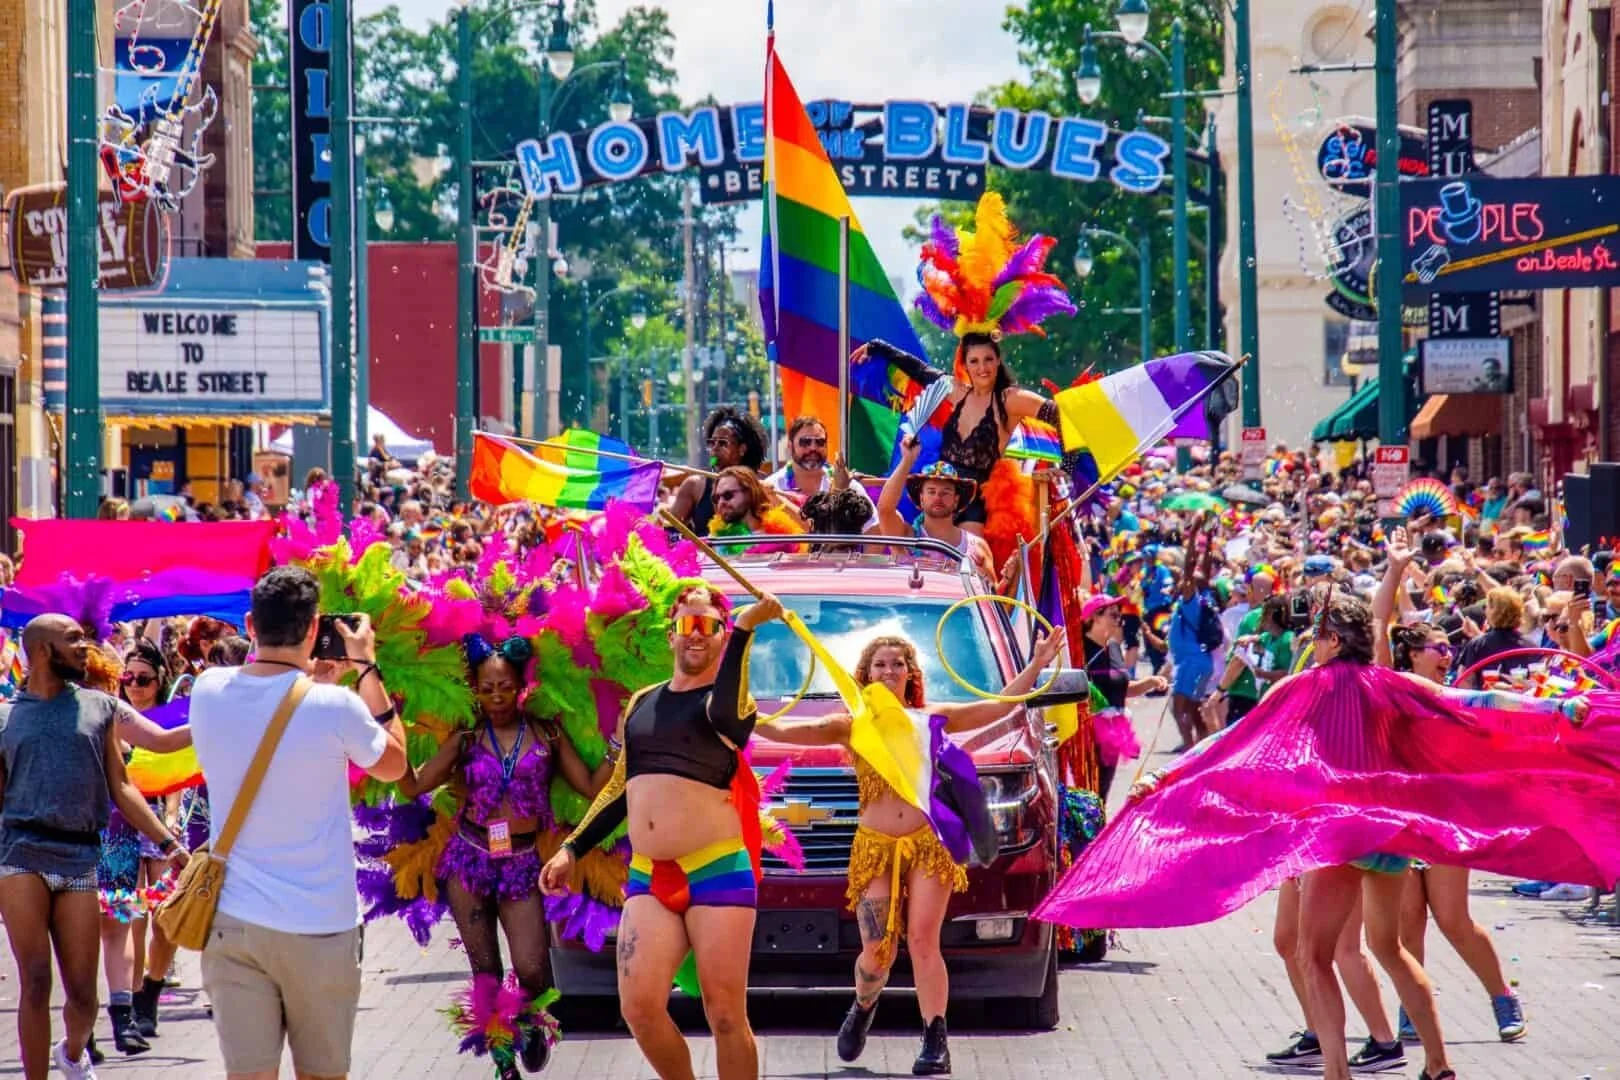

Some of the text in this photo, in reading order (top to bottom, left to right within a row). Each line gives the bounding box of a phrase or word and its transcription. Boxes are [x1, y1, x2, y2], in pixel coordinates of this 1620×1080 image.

[883, 99, 1170, 192] BLUES
[840, 164, 962, 190] STREET
[1541, 248, 1592, 272] Beale
[143, 312, 237, 335] WELCOME
[181, 343, 204, 364] TO
[126, 371, 267, 393] BEALE STREET
